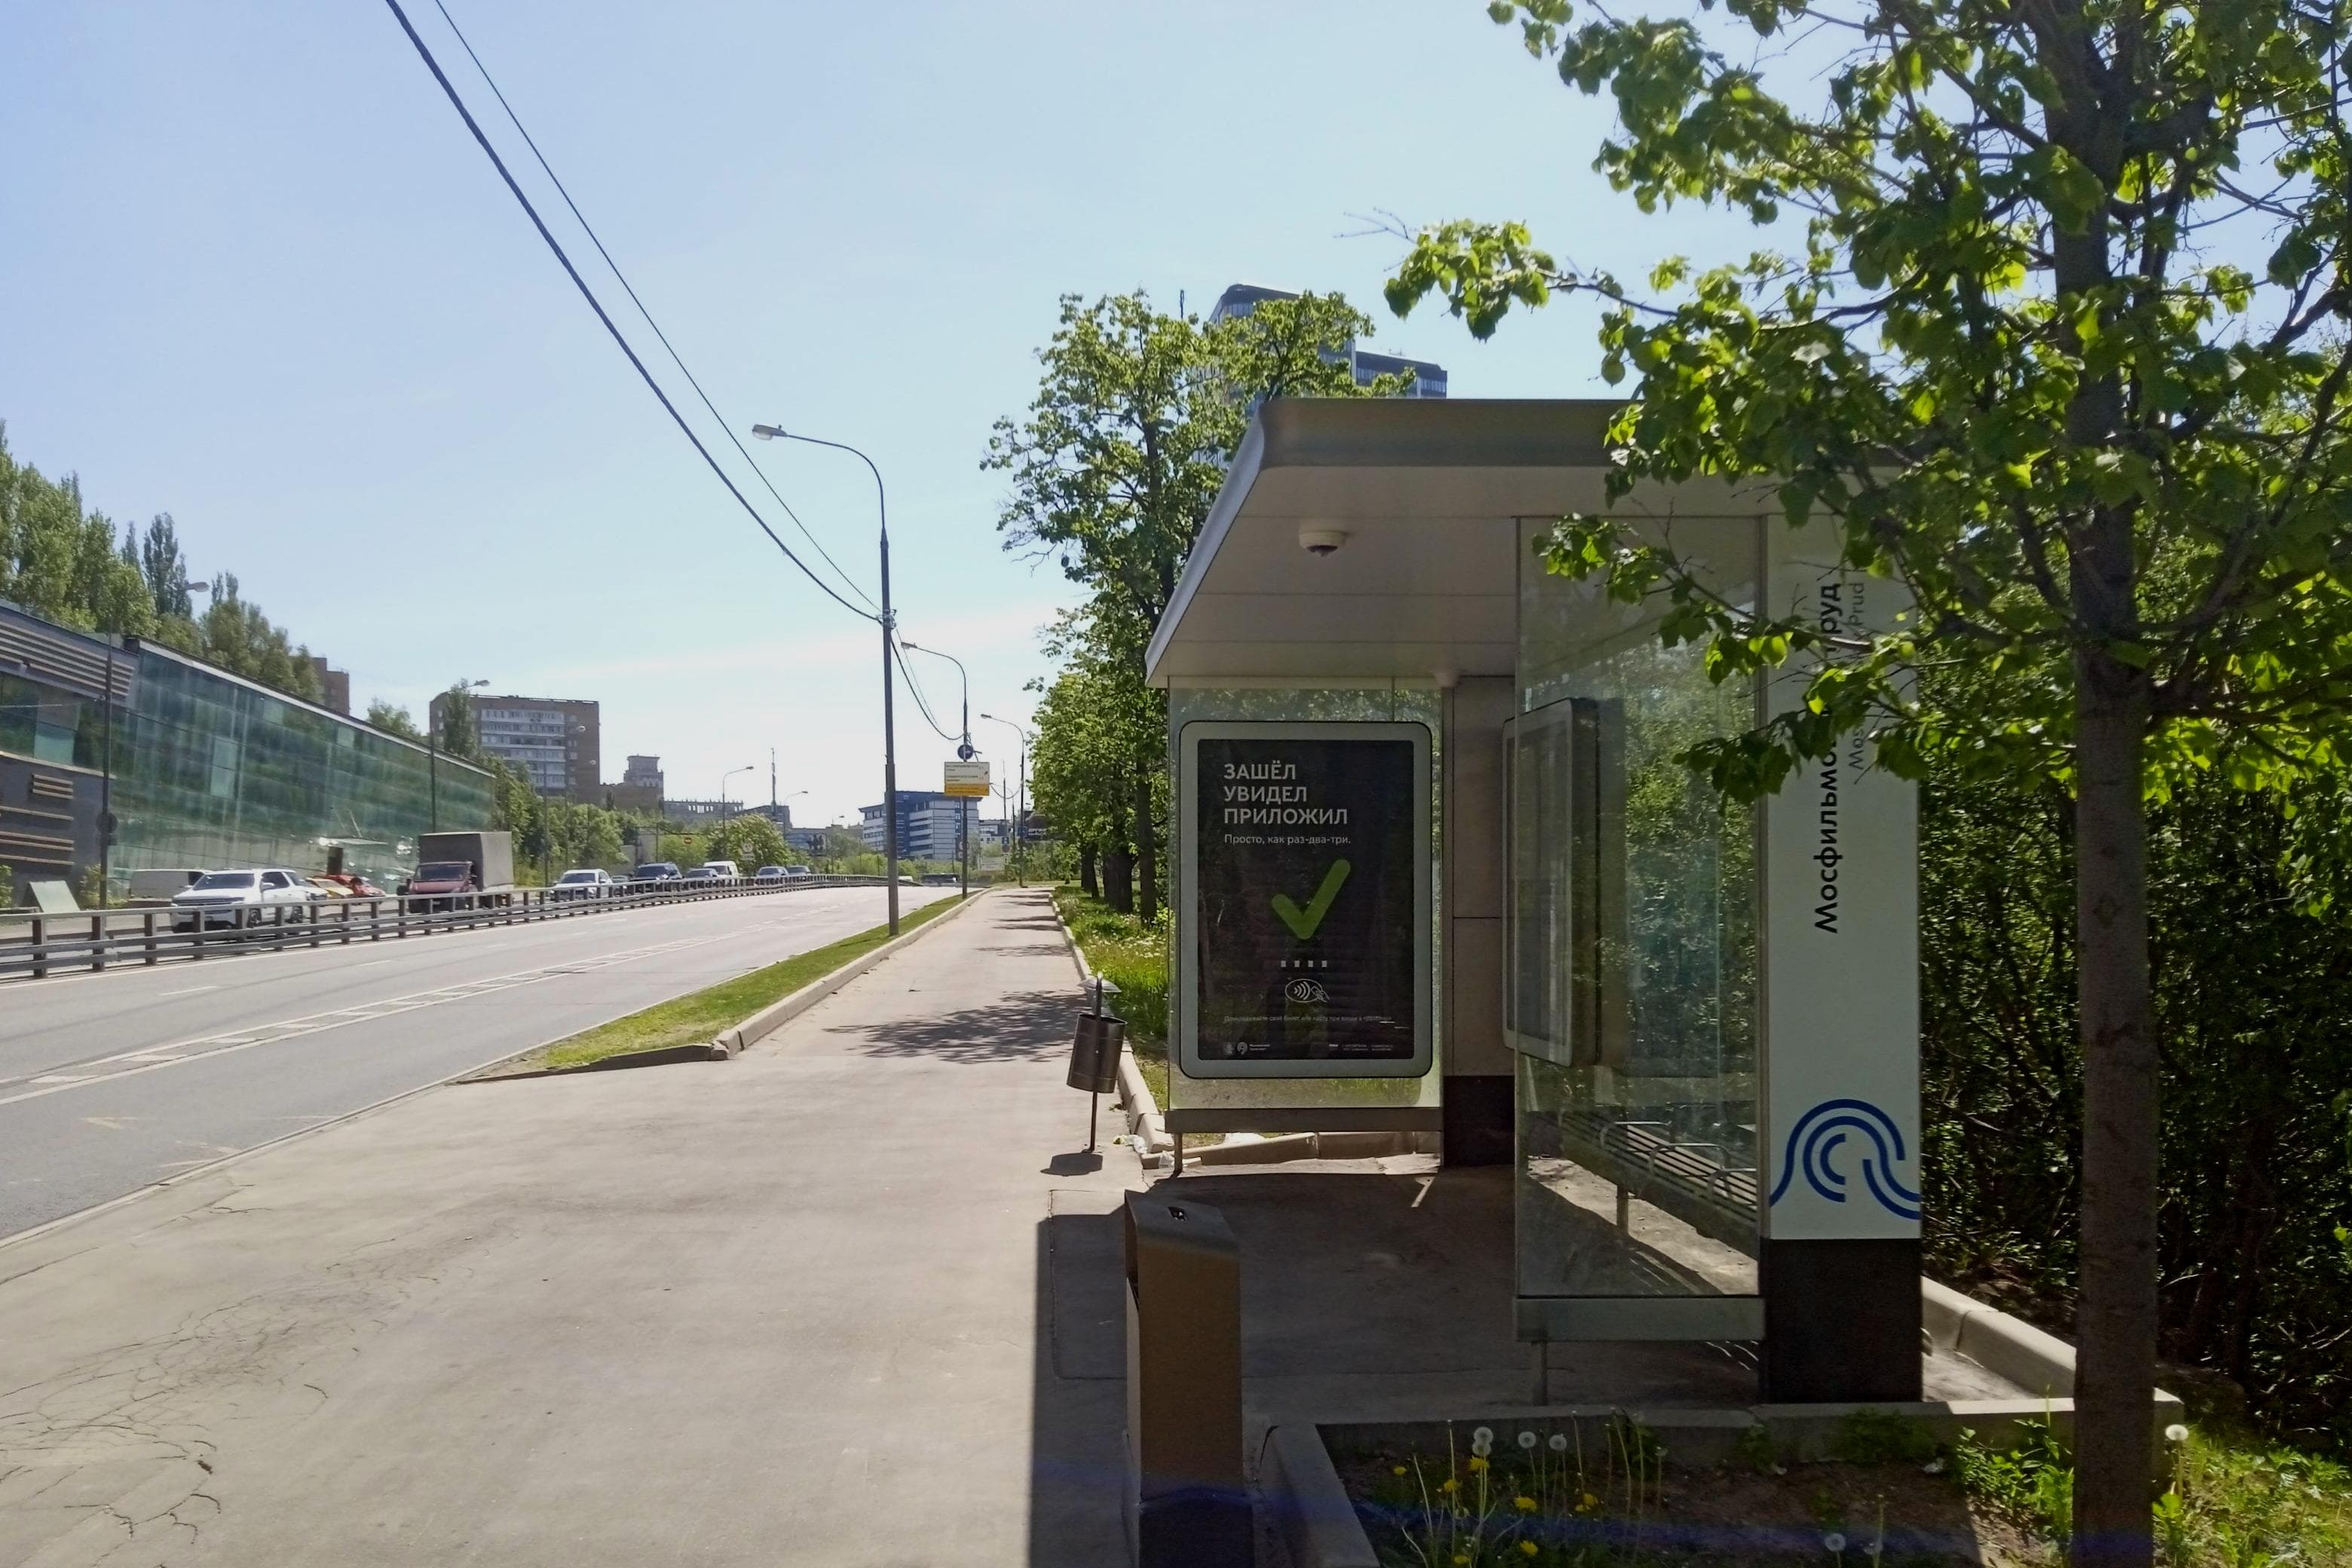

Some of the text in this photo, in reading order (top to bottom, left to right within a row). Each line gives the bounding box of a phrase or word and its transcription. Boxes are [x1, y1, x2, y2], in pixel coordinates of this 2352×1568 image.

[1848, 583, 1865, 626] Prud
[1223, 760, 1296, 779] ЗАШЁЛ
[1223, 786, 1307, 804] УВИДЕЛ
[1223, 808, 1348, 825] ПРИЛОЖИЛ
[1813, 707, 1843, 934] Мосфильмо
[1224, 834, 1265, 845] Просто,
[1287, 836, 1352, 845] раз-два-три.
